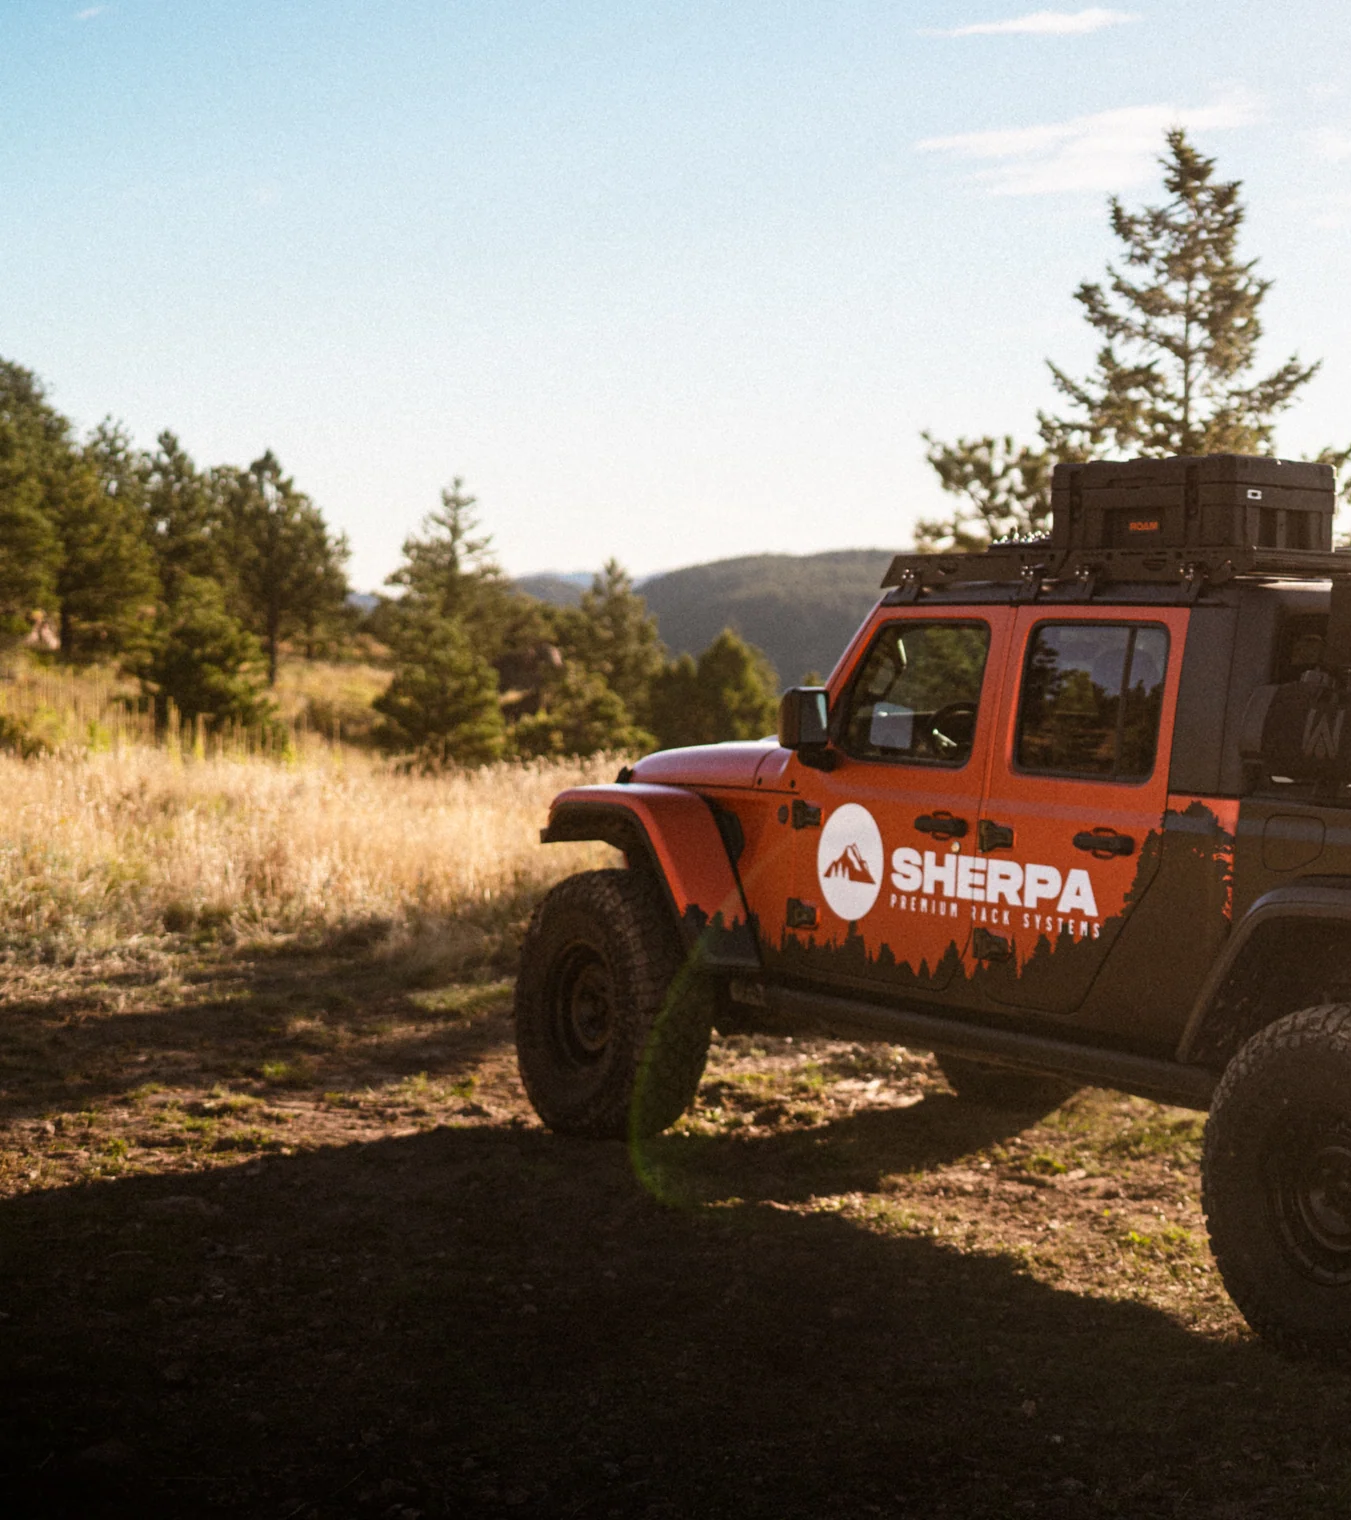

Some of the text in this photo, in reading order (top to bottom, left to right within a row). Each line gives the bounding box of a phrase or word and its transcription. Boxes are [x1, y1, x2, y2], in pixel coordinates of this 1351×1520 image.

[1129, 521, 1158, 531] ROAM
[891, 847, 1099, 917] SHERPA
[890, 893, 958, 918] PREMIUM
[1023, 913, 1100, 939] SYSTEMS
